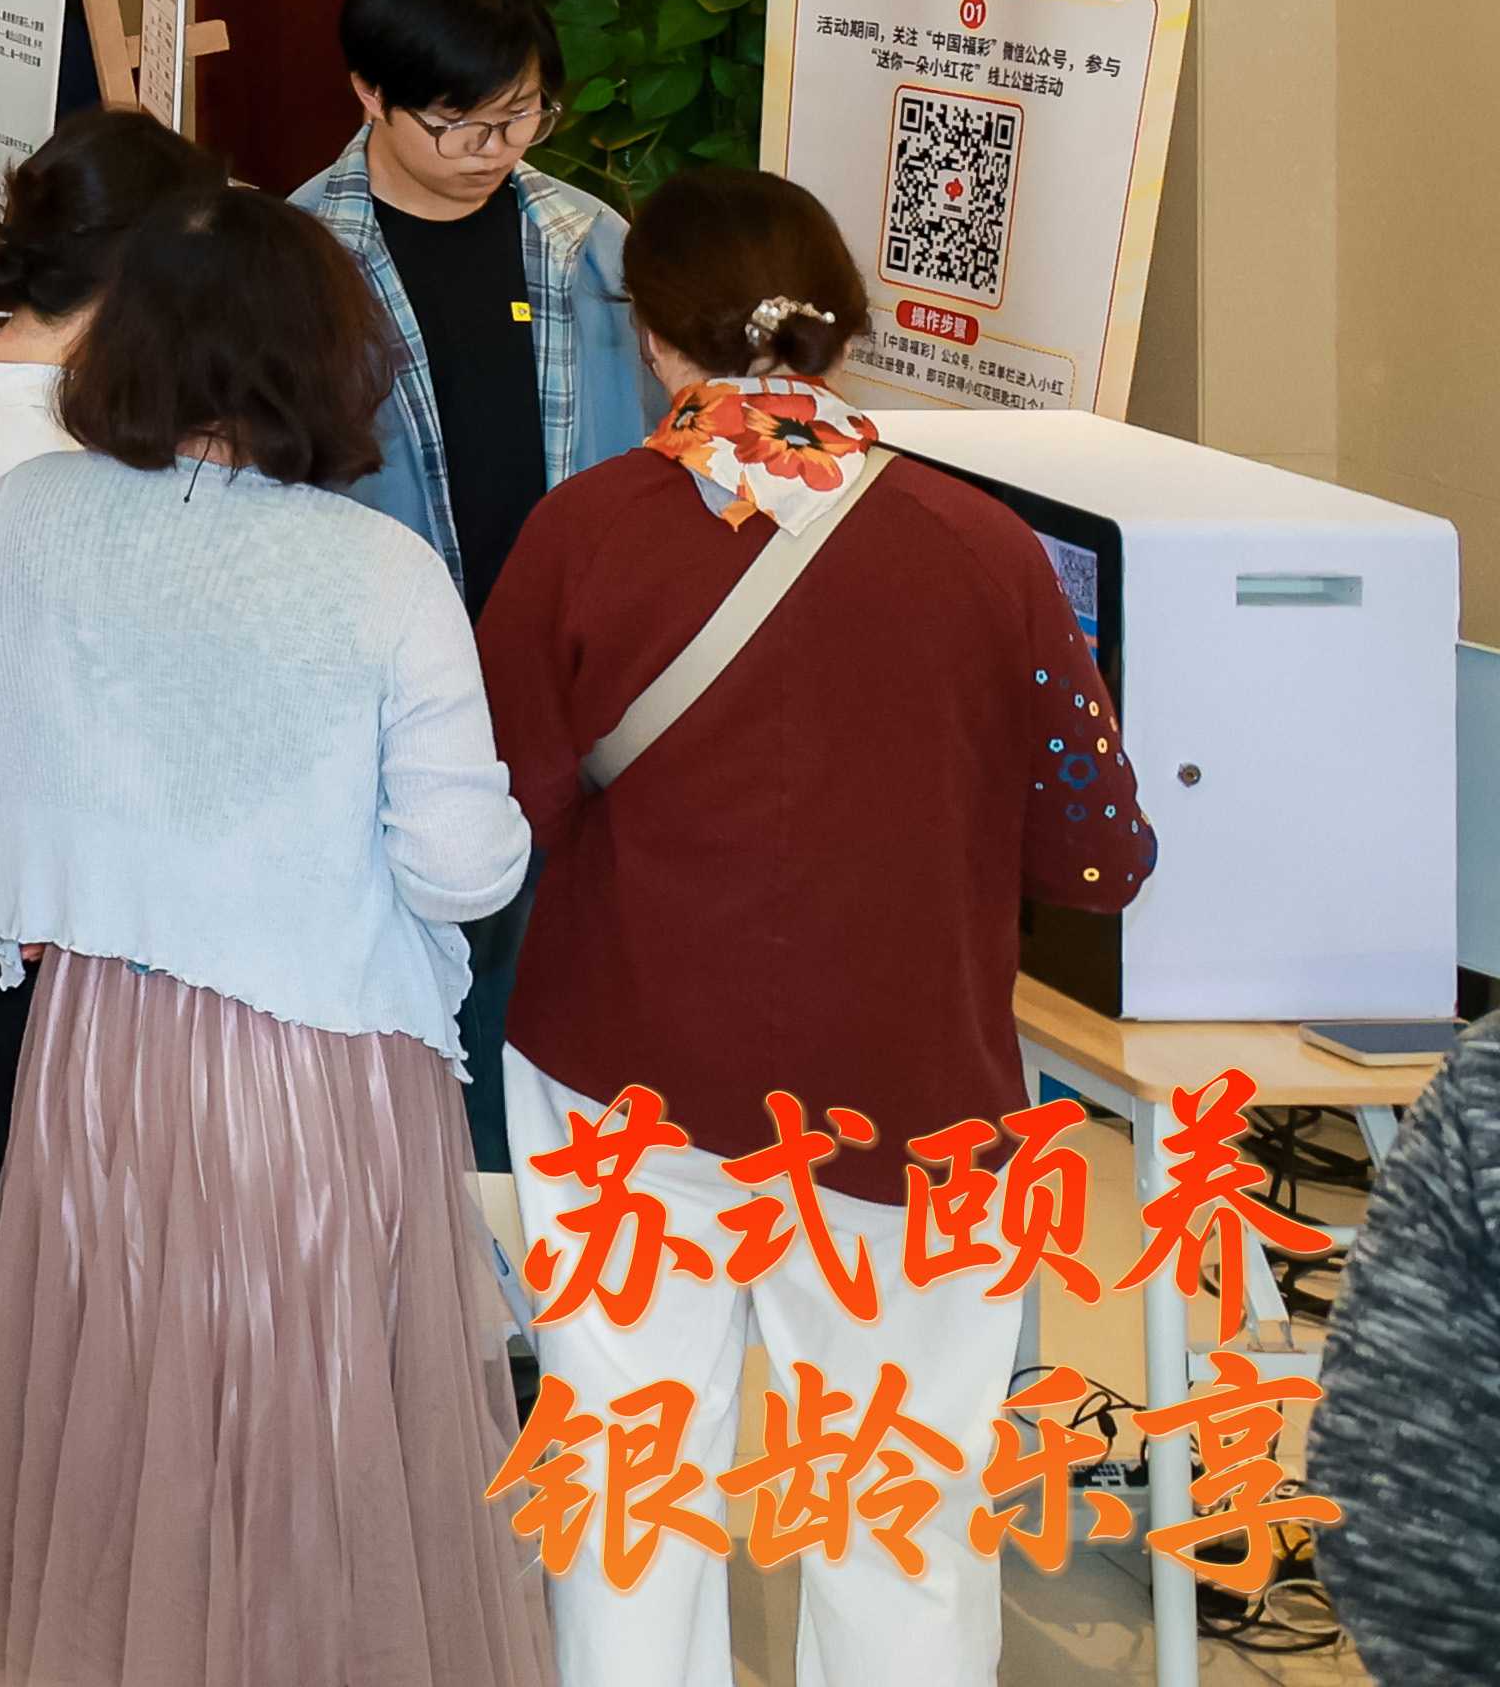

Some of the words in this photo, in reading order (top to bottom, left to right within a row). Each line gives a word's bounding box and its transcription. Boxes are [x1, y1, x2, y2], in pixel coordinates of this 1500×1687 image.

[962, 2, 983, 23] 01
[911, 306, 967, 340] 操作步骤
